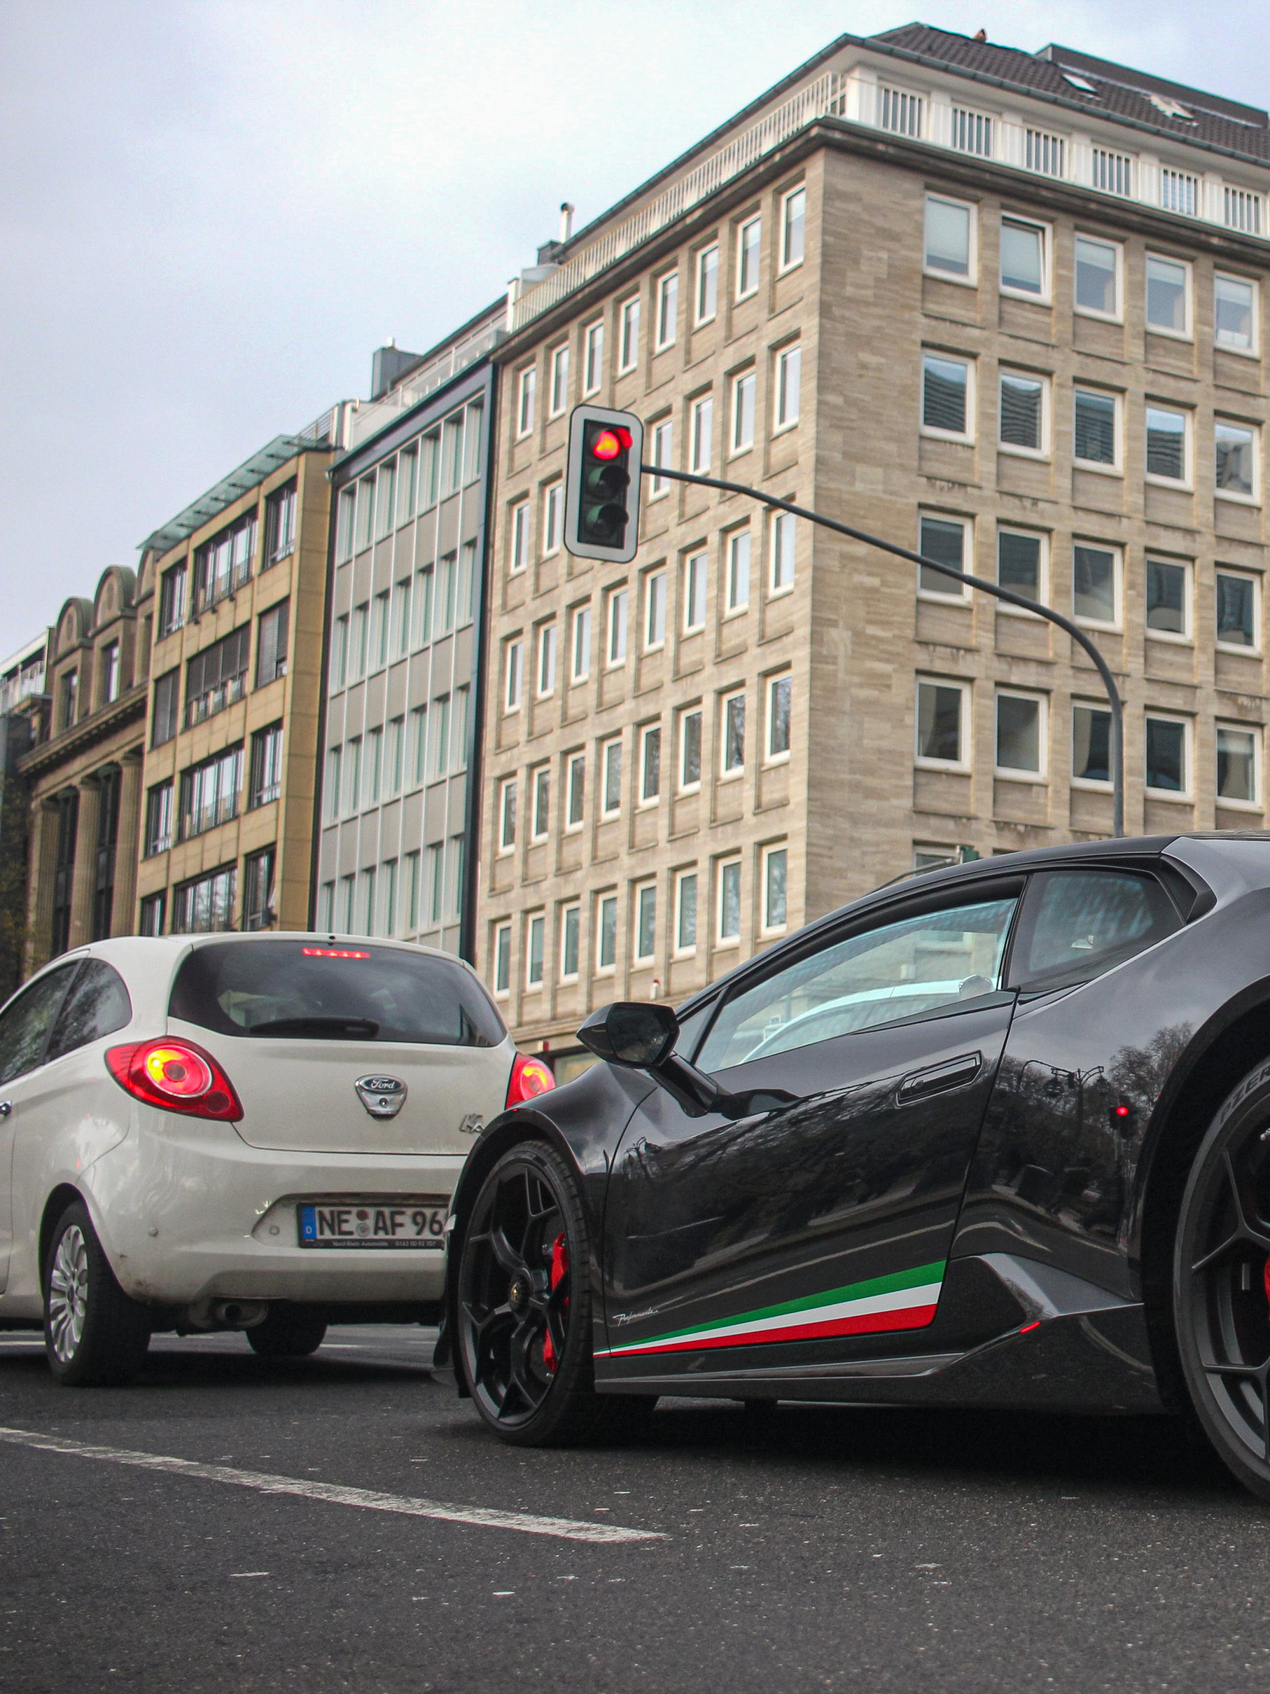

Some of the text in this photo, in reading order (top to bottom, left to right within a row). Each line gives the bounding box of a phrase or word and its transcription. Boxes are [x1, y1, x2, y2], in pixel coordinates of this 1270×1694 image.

[370, 1079, 396, 1089] Ford
[317, 1209, 443, 1236] NE AF 96
